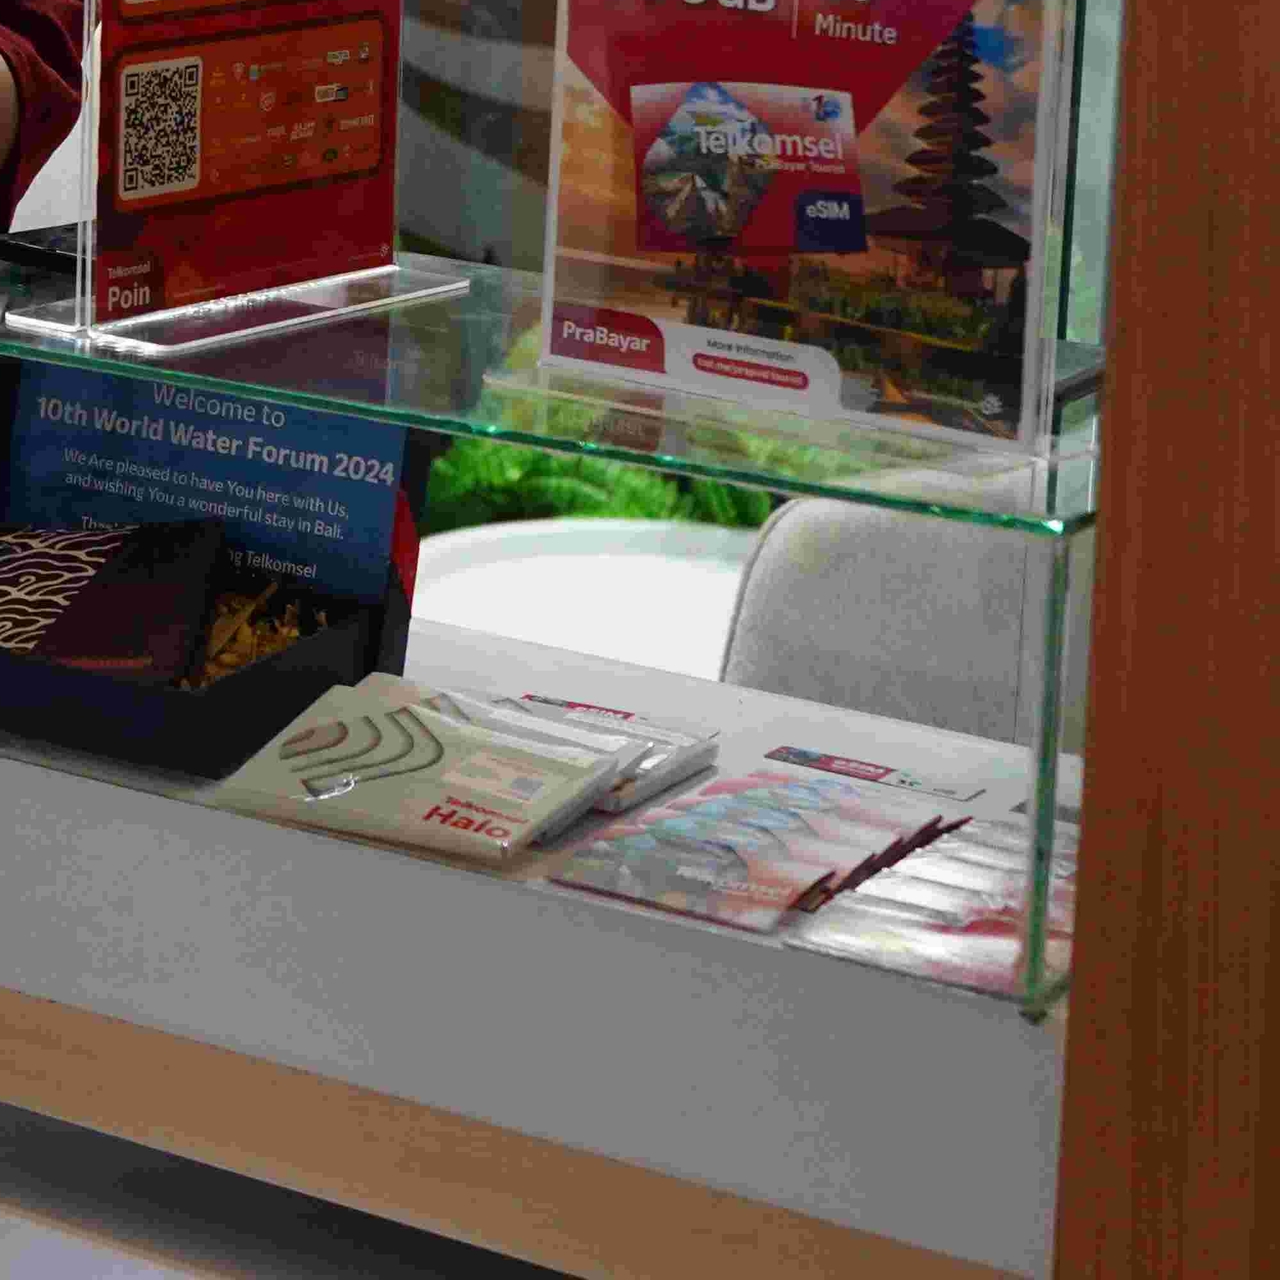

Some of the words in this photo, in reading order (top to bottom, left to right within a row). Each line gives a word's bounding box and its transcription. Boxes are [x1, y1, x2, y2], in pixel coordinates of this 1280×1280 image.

[815, 13, 897, 45] Minute
[694, 121, 843, 160] Telkomsel
[806, 200, 851, 220] eSIM
[107, 260, 151, 278] Telkomsel
[107, 282, 150, 311] Poin
[562, 319, 651, 354] PraBayar
[152, 382, 256, 423] Welcome
[262, 404, 286, 429] to
[37, 396, 88, 426] 10th
[92, 407, 164, 441] World
[169, 422, 242, 456] Water
[247, 435, 329, 474] Forum
[334, 454, 396, 486] 2024
[63, 447, 87, 465] We
[88, 452, 114, 471] Are
[116, 458, 171, 483] pleased
[173, 469, 188, 486] to
[190, 470, 224, 493] have
[227, 480, 256, 500] You
[257, 485, 290, 507] here
[293, 492, 325, 513] with
[328, 498, 350, 520] Us,
[65, 470, 93, 489] and
[94, 477, 145, 503] wishing
[148, 486, 175, 506] You
[177, 494, 186, 506] a
[188, 495, 263, 523] wonderful
[264, 508, 295, 532] stay
[298, 513, 311, 532] in
[314, 515, 345, 540] Bali.
[245, 549, 317, 579] Telkomsel
[422, 805, 512, 839] Halo
